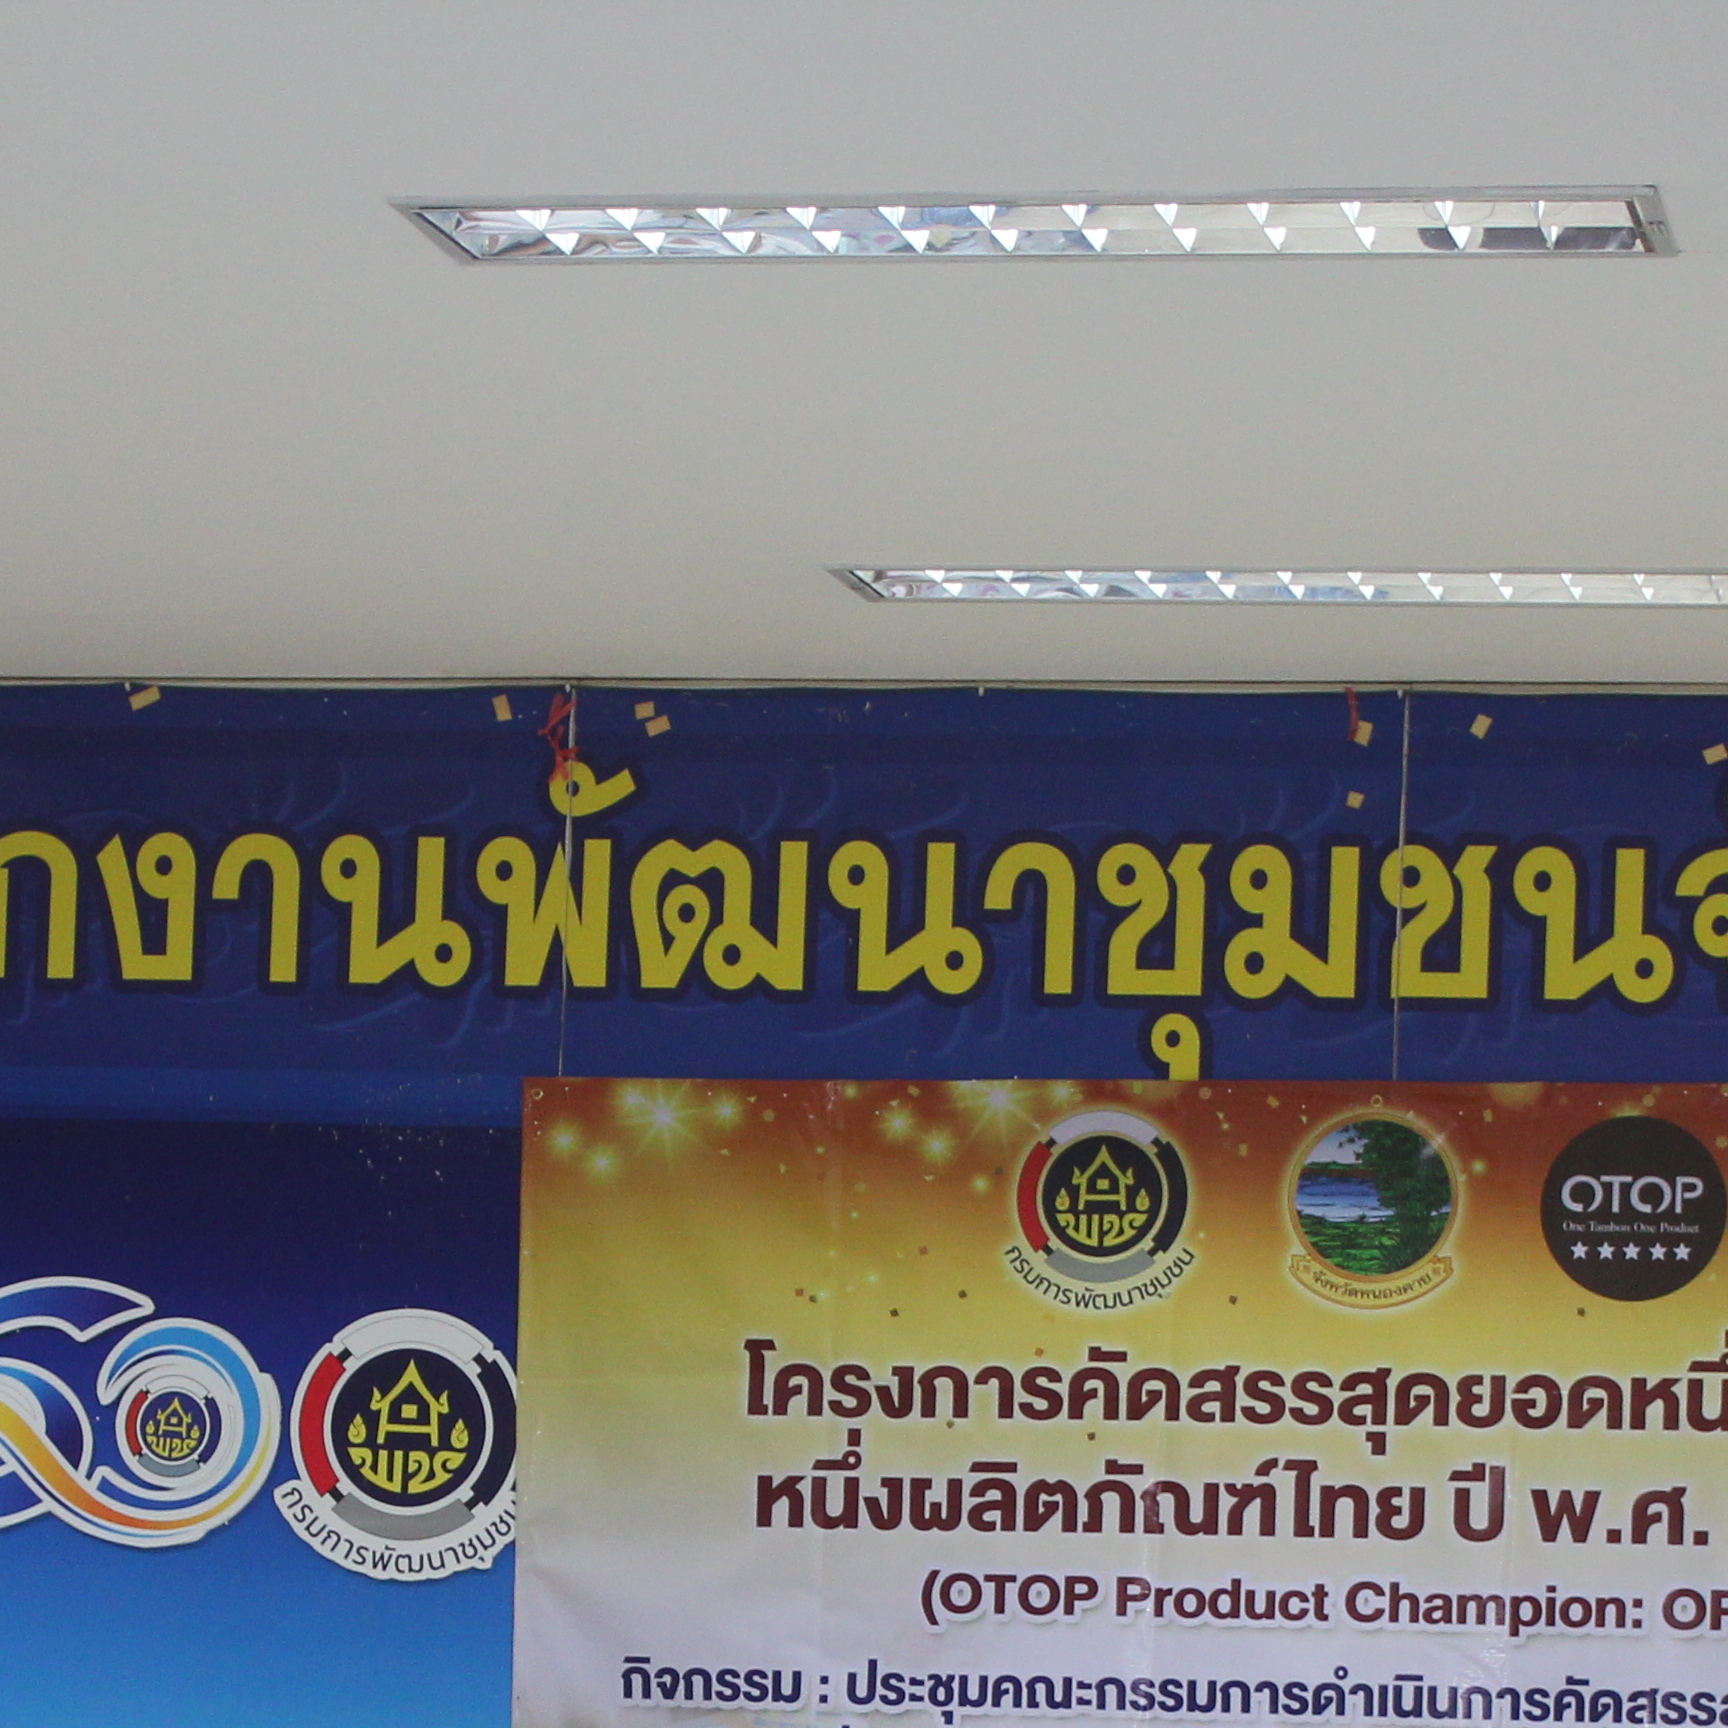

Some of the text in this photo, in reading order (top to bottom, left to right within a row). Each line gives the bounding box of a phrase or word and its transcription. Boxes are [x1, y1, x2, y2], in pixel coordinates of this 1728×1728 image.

[1561, 1174, 1704, 1214] OTOP
[1562, 1220, 1700, 1234] One Tambon One Product
[1004, 1245, 1196, 1310] กรมการพัฒนาชุมชน
[1312, 1270, 1432, 1300] จังหวัดหนองคาย
[755, 1427, 1426, 1541] หนึ่งผลิตภัณฑ์ไทย
[1448, 1462, 1506, 1542] ปี
[1530, 1485, 1709, 1546] พ.ศ.
[920, 1568, 1099, 1626] (OTOP
[1115, 1575, 1329, 1622] Product
[1344, 1580, 1643, 1638] Champion:
[620, 1656, 802, 1703] กิจกรรม
